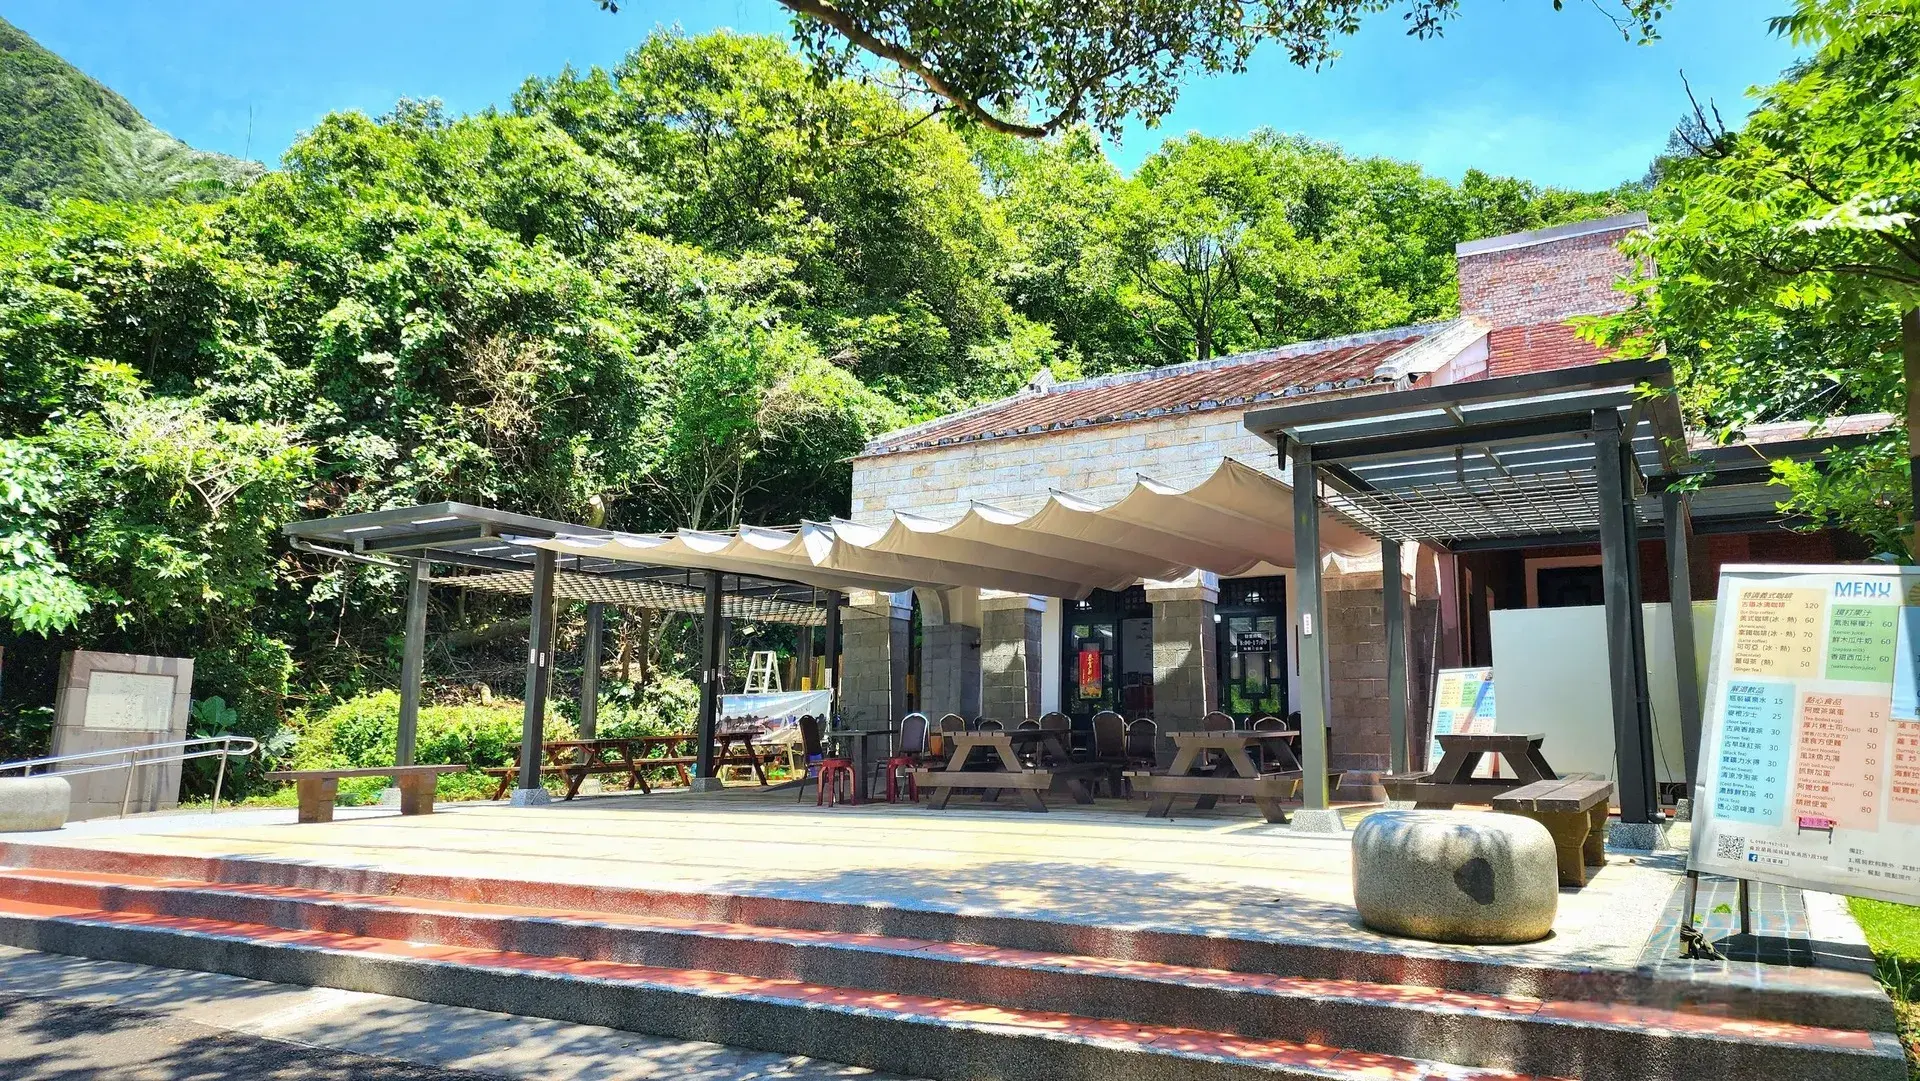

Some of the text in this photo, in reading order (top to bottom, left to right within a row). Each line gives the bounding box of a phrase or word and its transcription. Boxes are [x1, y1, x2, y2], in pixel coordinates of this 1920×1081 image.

[1834, 582, 1891, 598] MENU
[1770, 728, 1781, 736] 30
[1765, 776, 1776, 784] 40
[1763, 792, 1774, 800] 40
[1762, 808, 1773, 816] 50
[1861, 806, 1872, 814] 80
